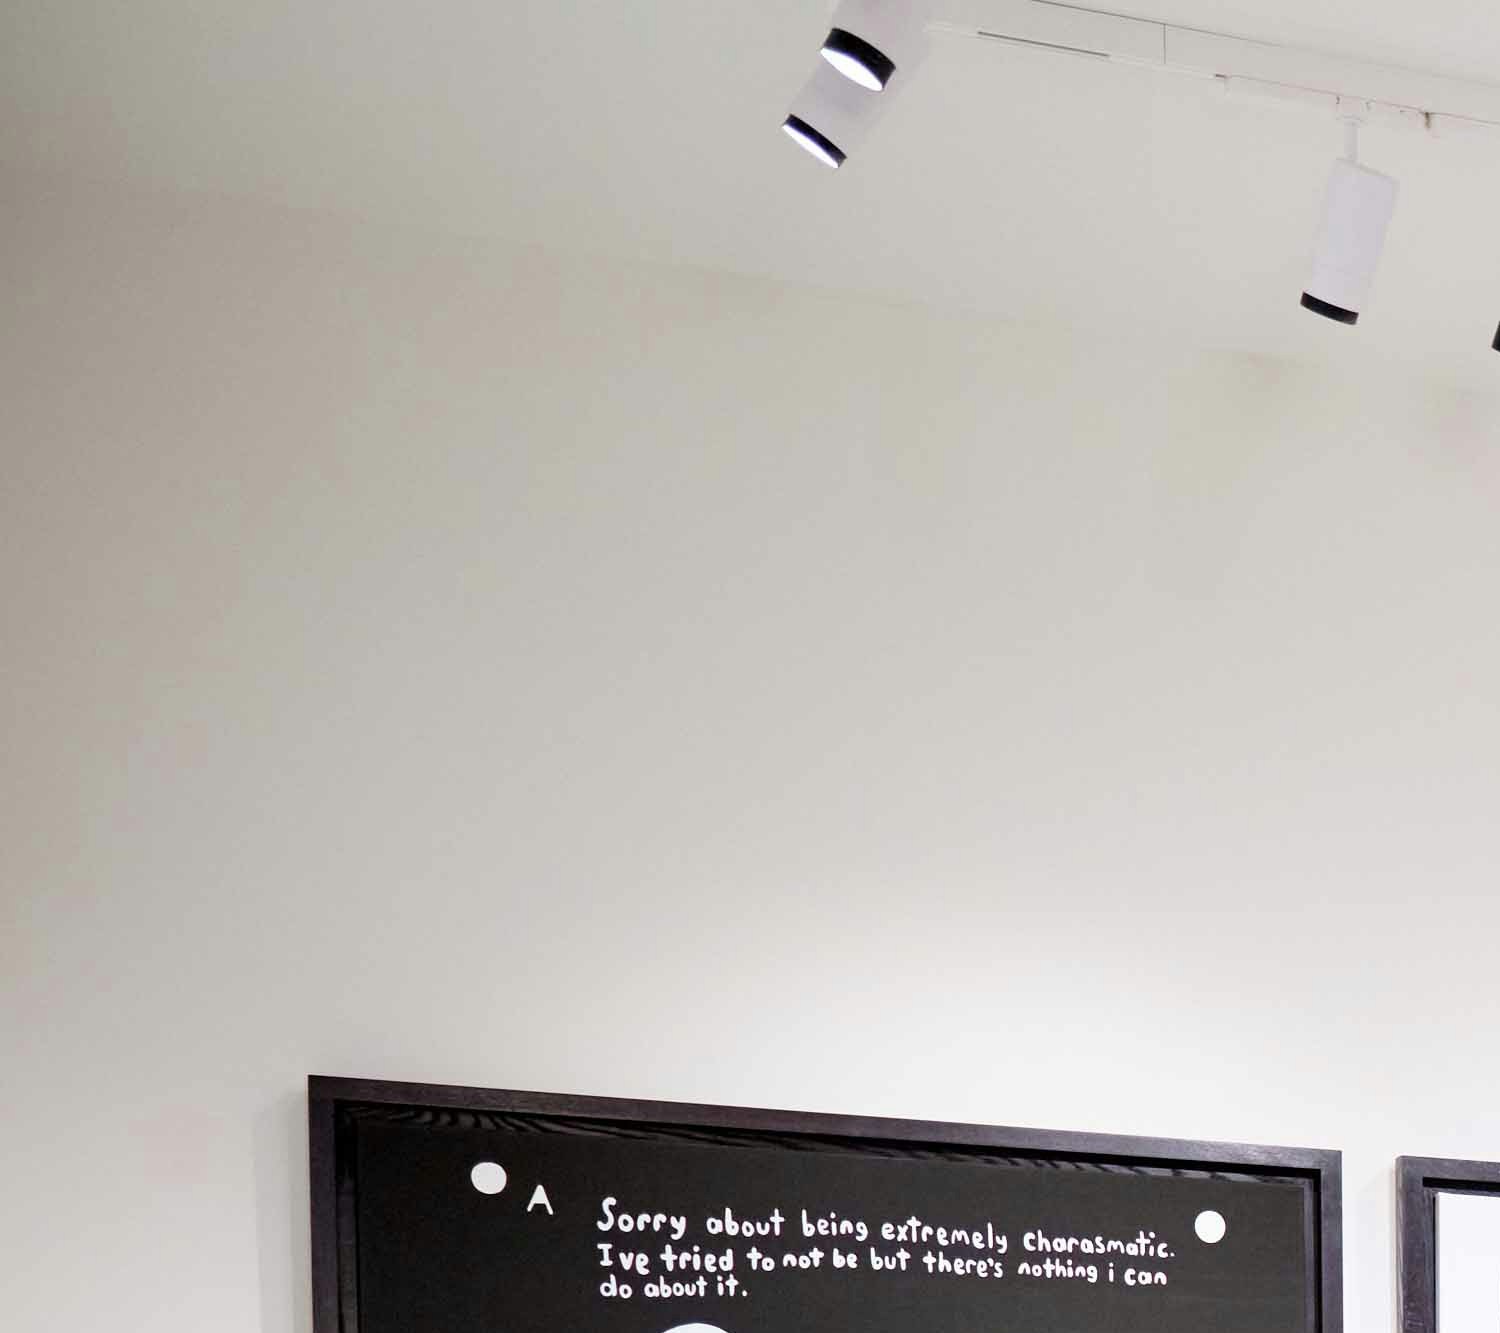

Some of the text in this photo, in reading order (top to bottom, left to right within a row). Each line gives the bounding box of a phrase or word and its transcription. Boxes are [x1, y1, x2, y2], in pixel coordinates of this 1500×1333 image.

[527, 1184, 554, 1215] A
[596, 1196, 1175, 1259] Sorry about being extremely charasmatic.
[659, 1244, 734, 1273] tried
[746, 1246, 776, 1272] to
[782, 1247, 825, 1269] not
[832, 1247, 858, 1269] be
[870, 1246, 911, 1271] but
[922, 1250, 1004, 1279] there's
[1017, 1257, 1098, 1284] nothing
[1108, 1262, 1114, 1283] i
[1123, 1268, 1168, 1286] can
[599, 1273, 748, 1299] do about it.
